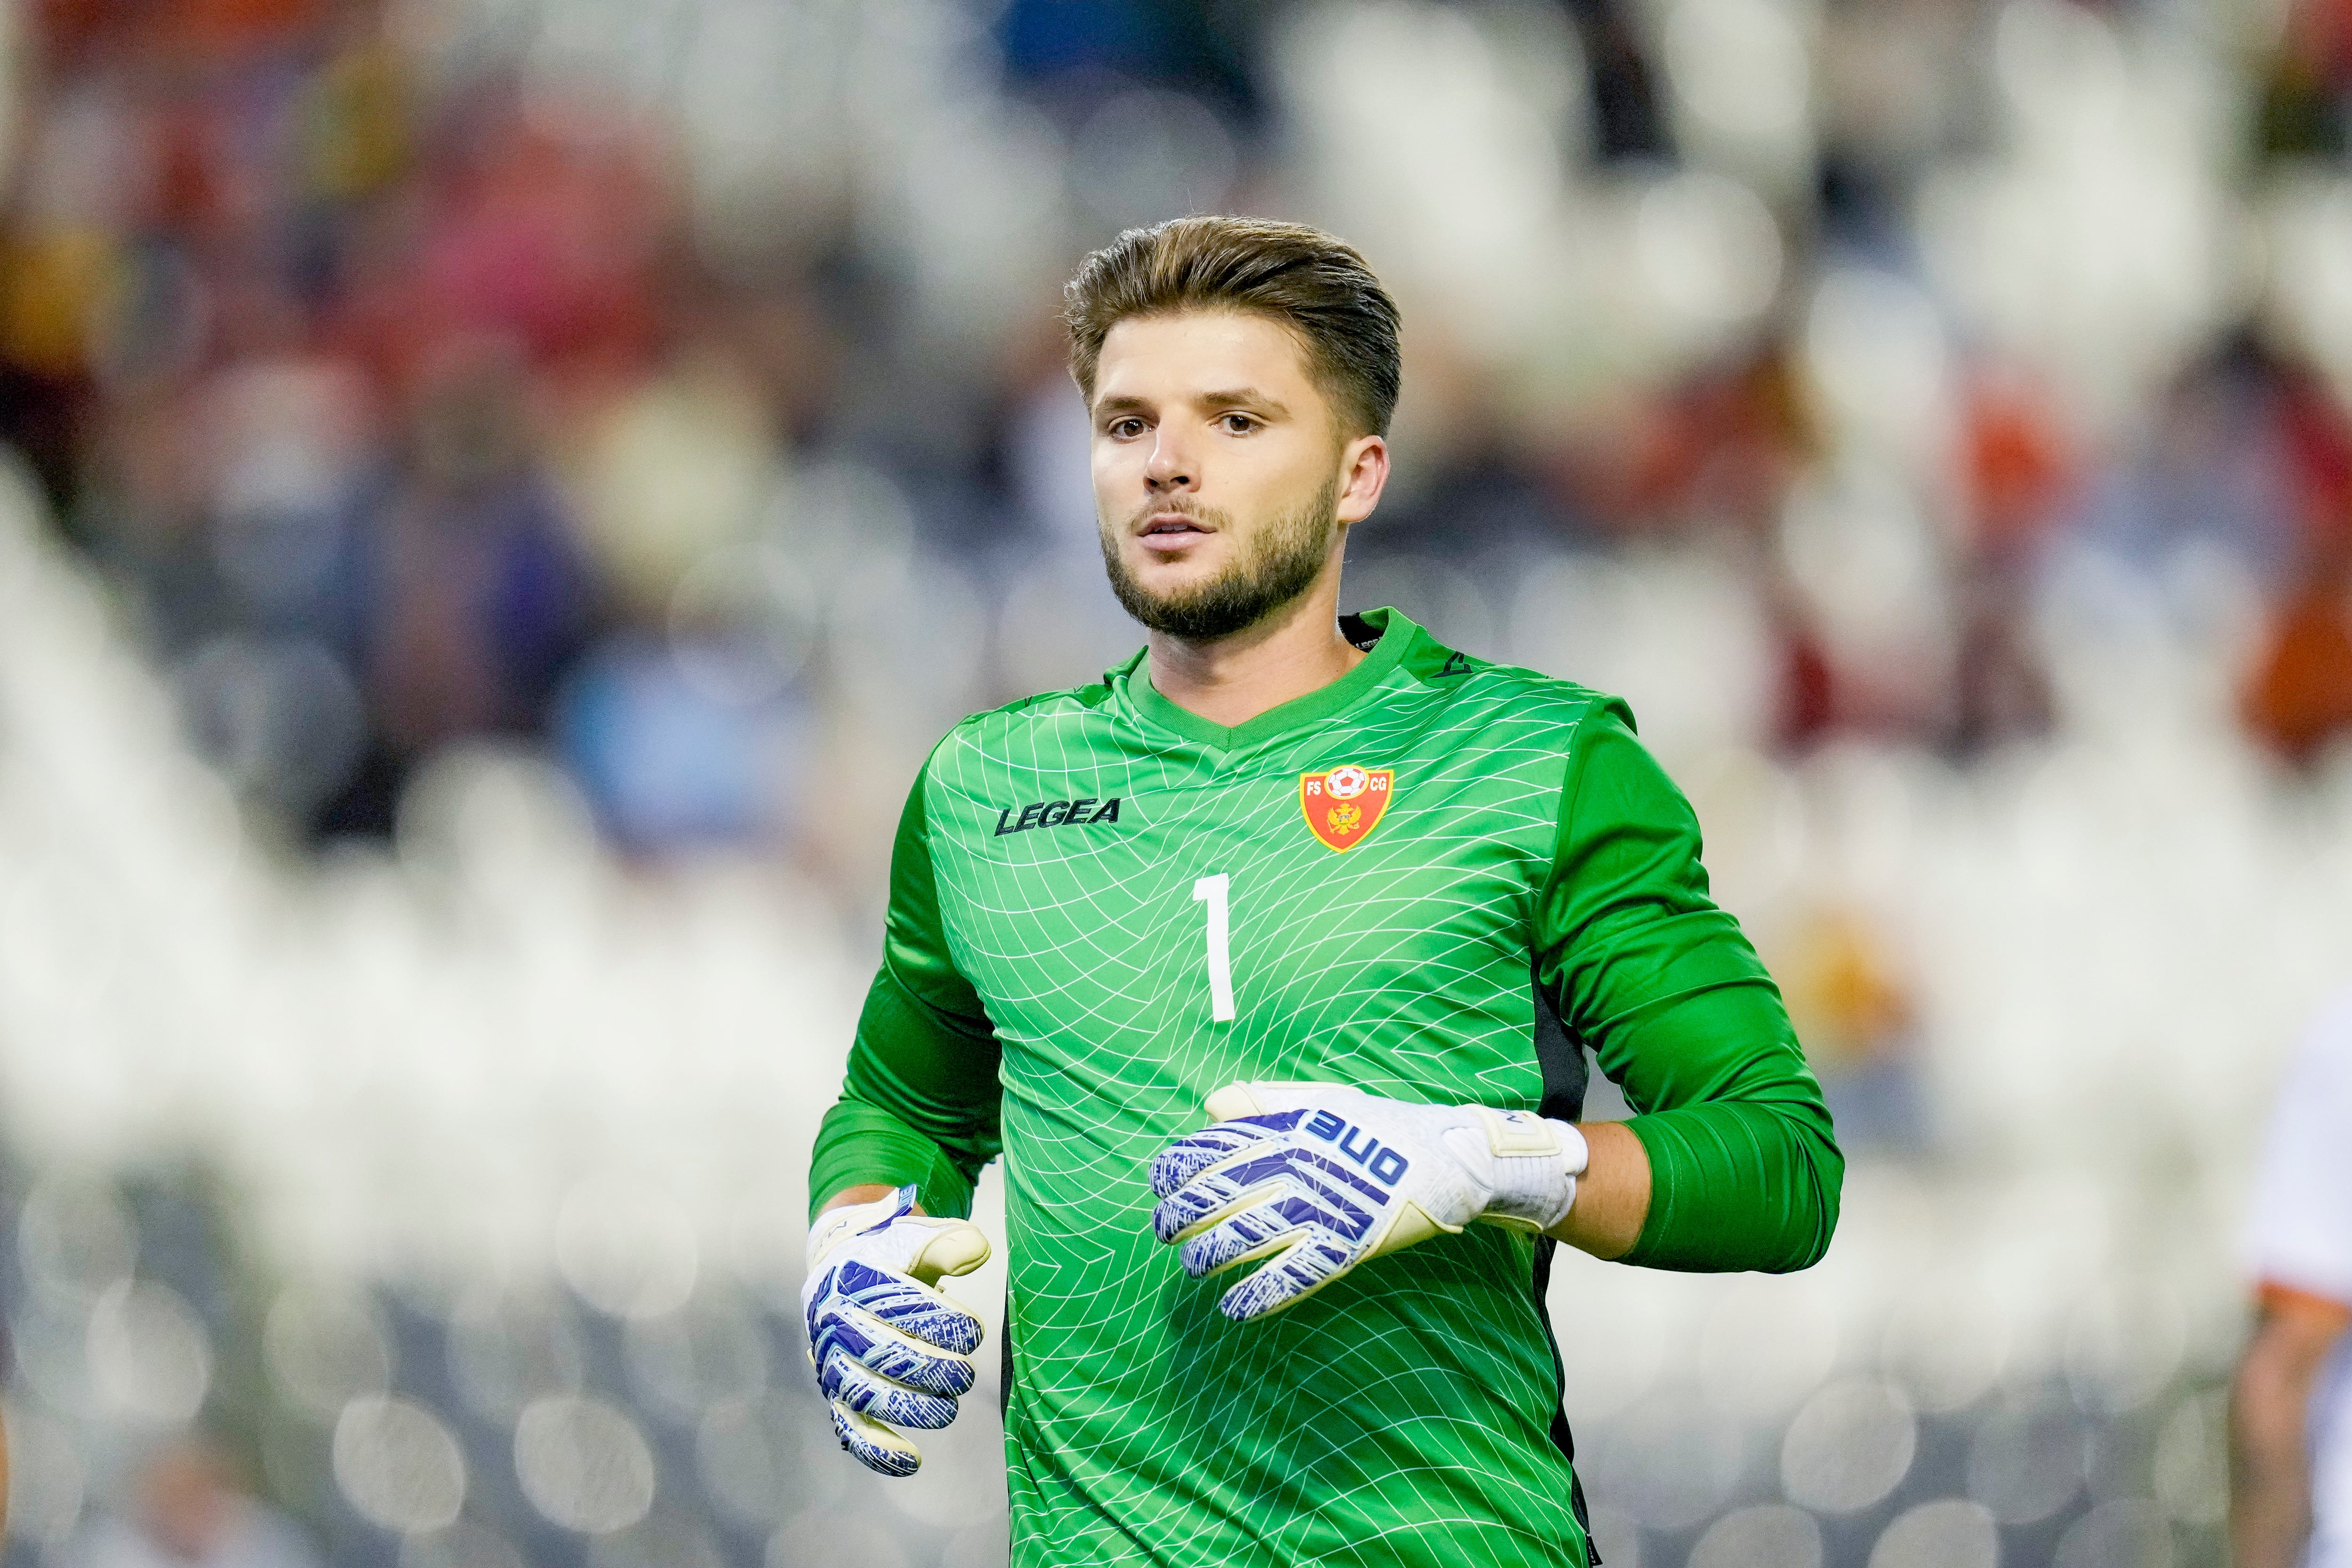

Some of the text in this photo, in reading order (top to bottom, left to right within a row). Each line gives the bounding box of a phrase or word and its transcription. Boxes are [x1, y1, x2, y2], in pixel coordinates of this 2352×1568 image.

[1306, 776, 1387, 796] FS CG
[994, 798, 1121, 836] LEGEA
[1192, 872, 1236, 1022] 1
